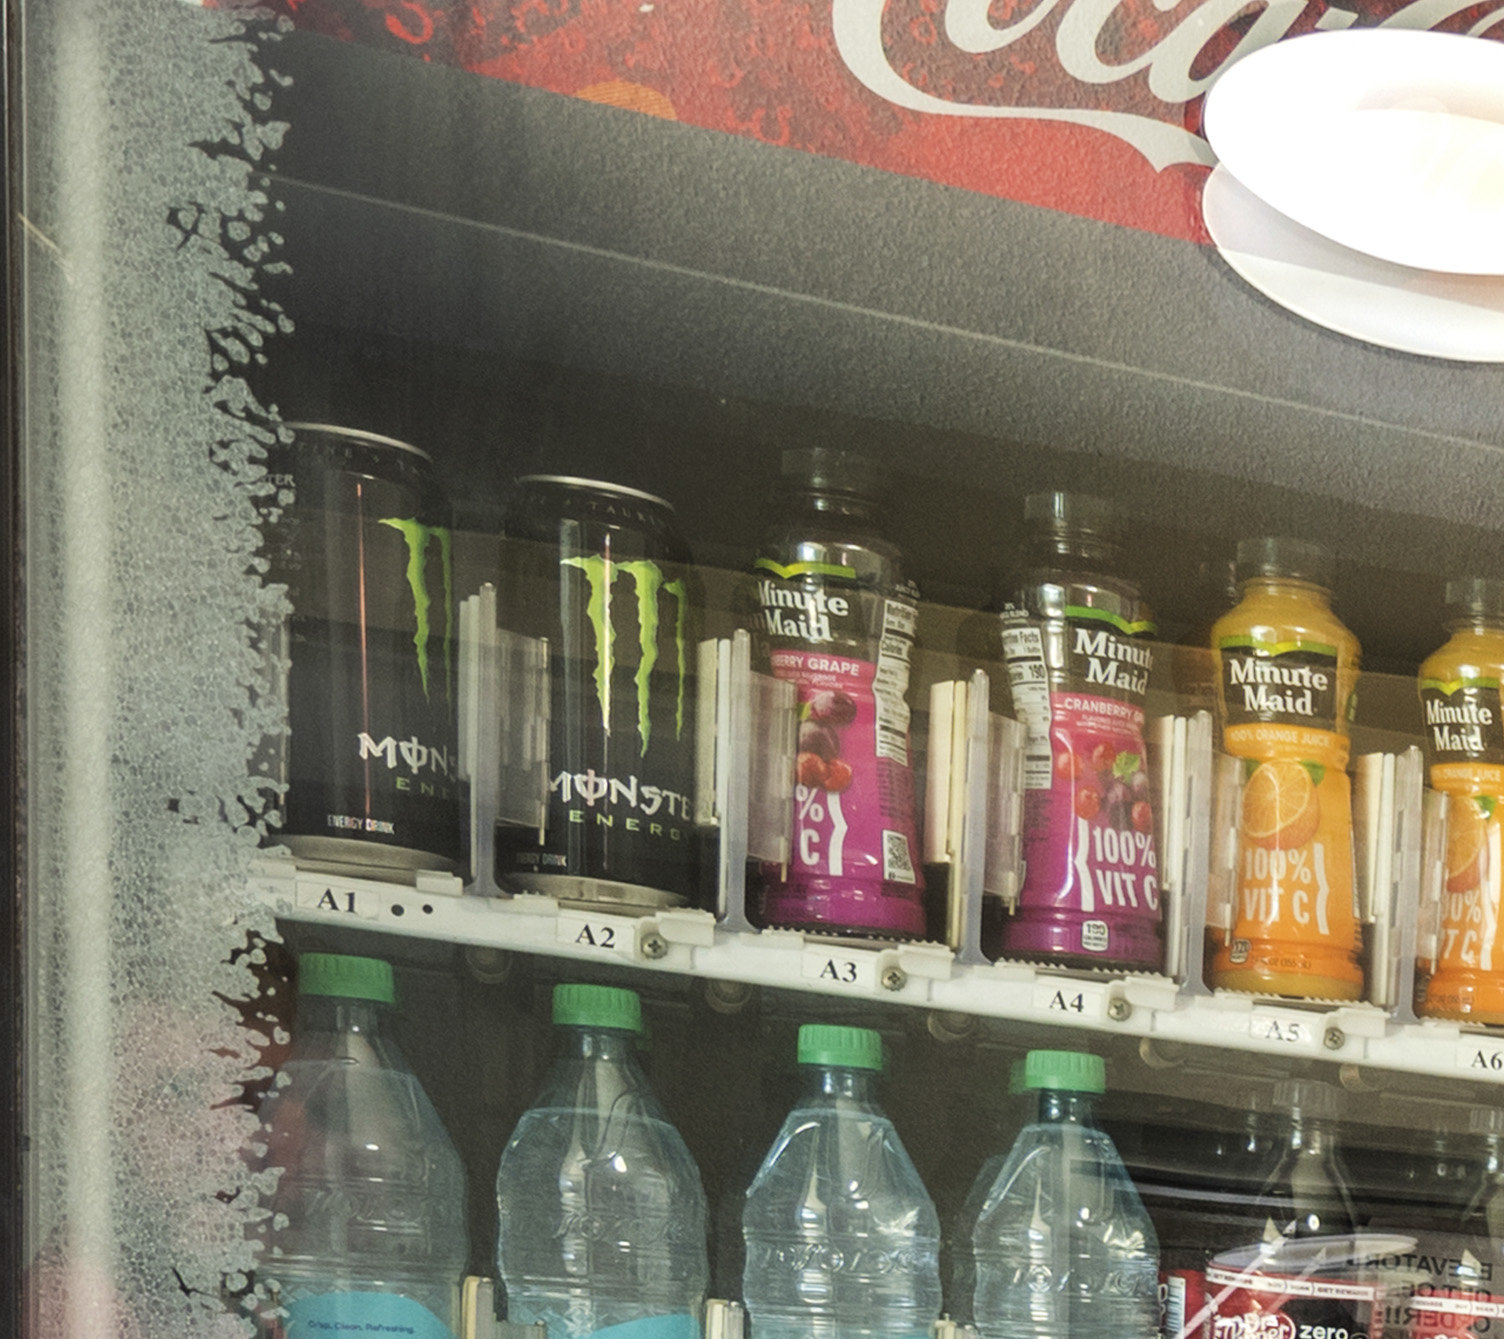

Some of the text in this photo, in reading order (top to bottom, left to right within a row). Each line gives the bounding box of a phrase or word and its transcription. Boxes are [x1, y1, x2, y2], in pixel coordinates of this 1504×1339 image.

[1228, 657, 1328, 691] Minute
[1243, 683, 1316, 716] Maid
[1244, 846, 1312, 882] 100%
[317, 888, 357, 915] A1
[1243, 889, 1309, 924] VIT C
[574, 925, 615, 949] A2
[819, 961, 858, 984] A3
[1048, 989, 1086, 1013] A4
[1470, 1050, 1503, 1072] A6
